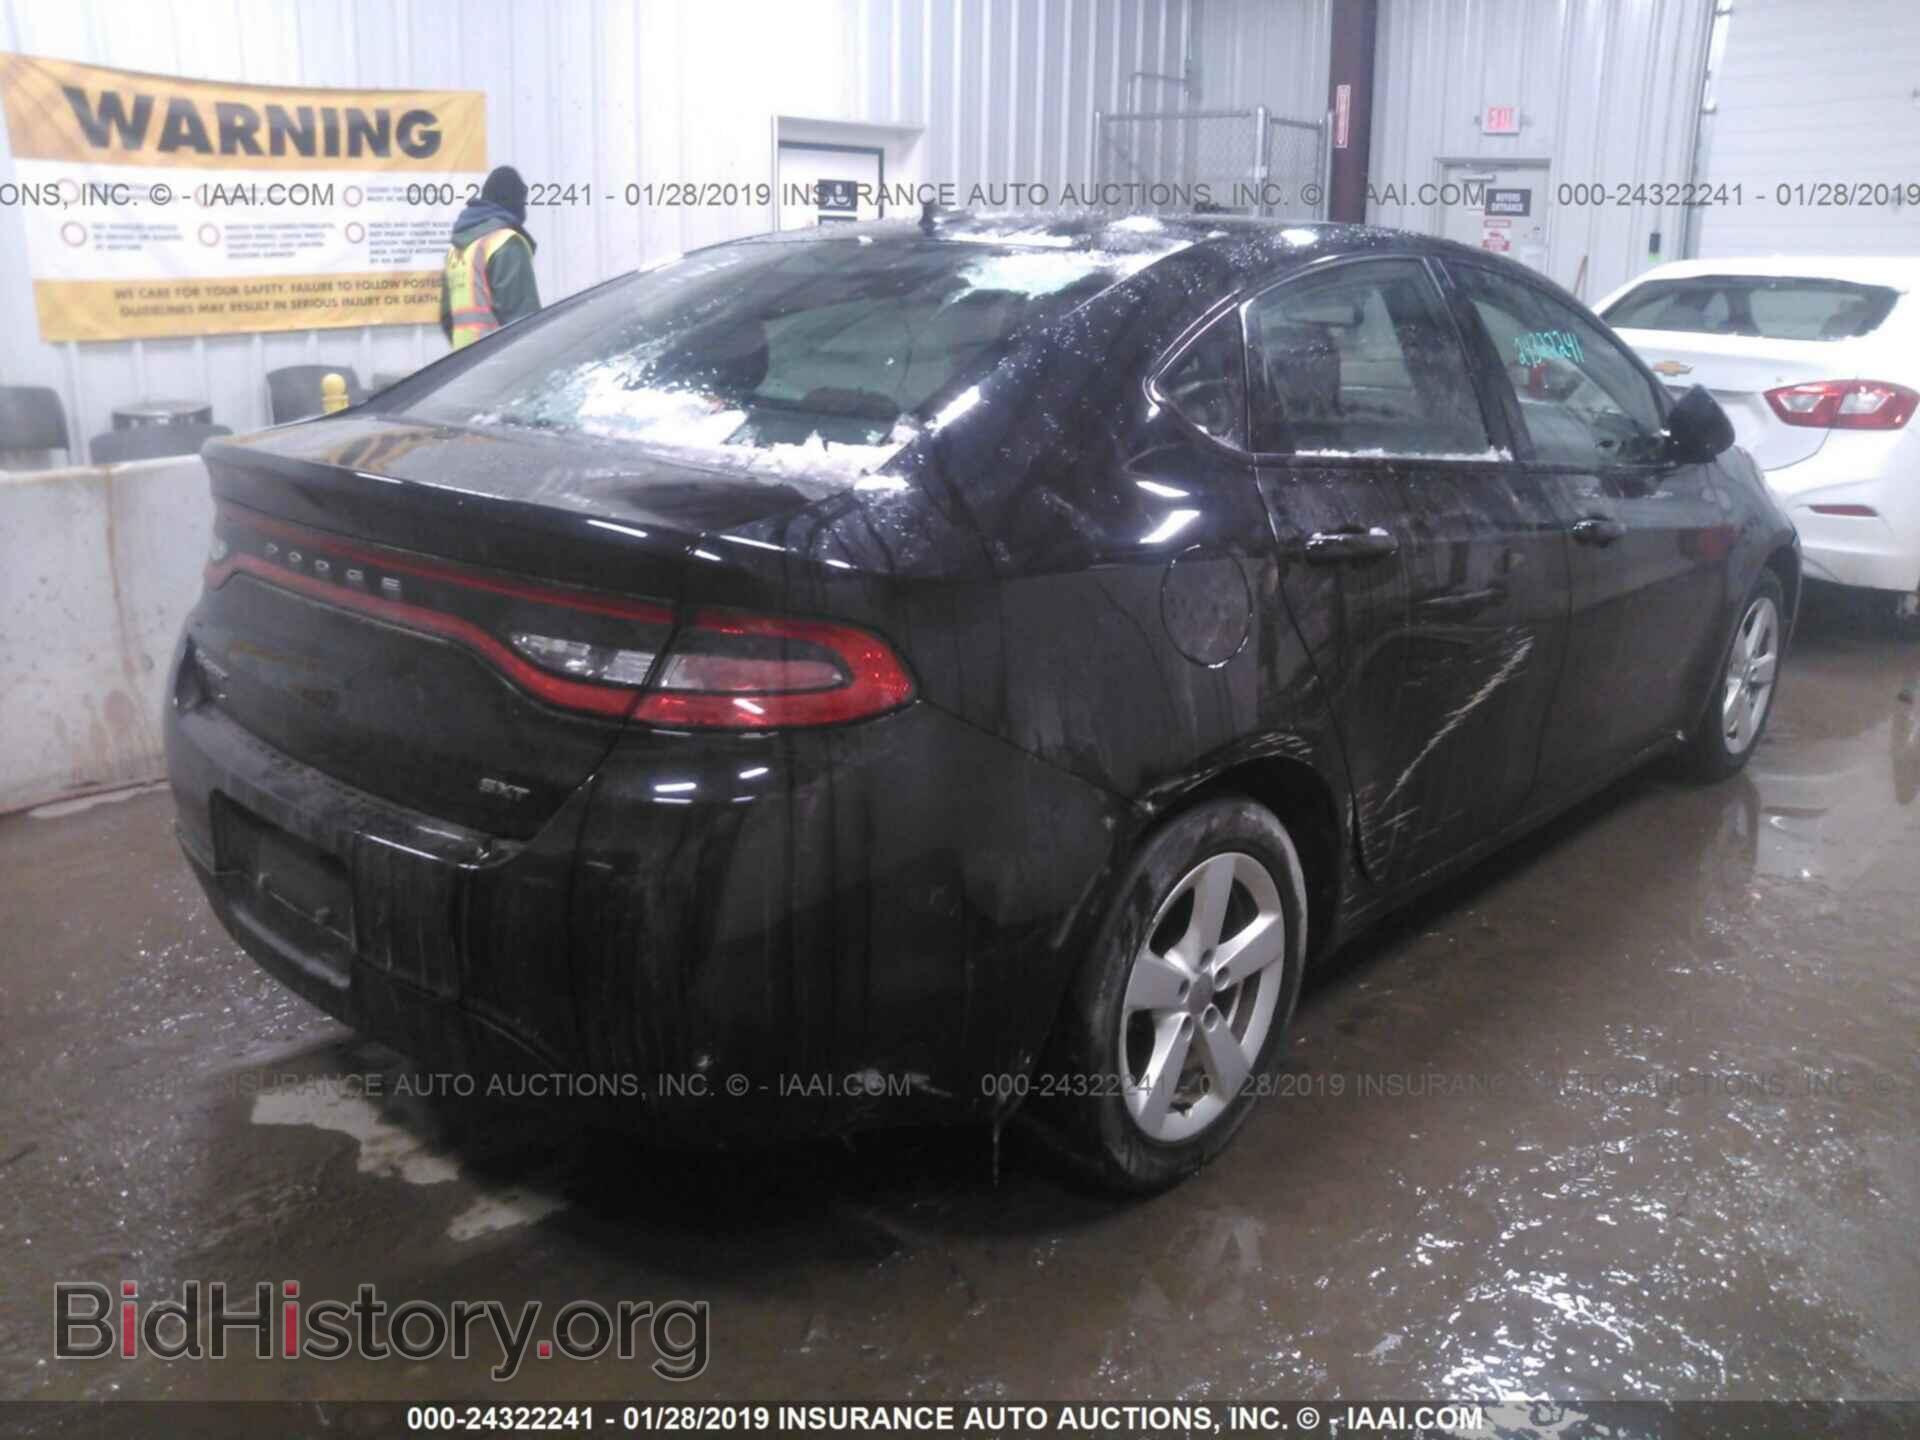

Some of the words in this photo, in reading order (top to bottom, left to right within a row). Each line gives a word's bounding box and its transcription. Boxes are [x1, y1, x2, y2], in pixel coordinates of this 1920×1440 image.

[62, 86, 442, 159] WARNING
[1488, 107, 1515, 128] EXIT
[338, 280, 353, 291] TO
[265, 542, 402, 591] DODGE
